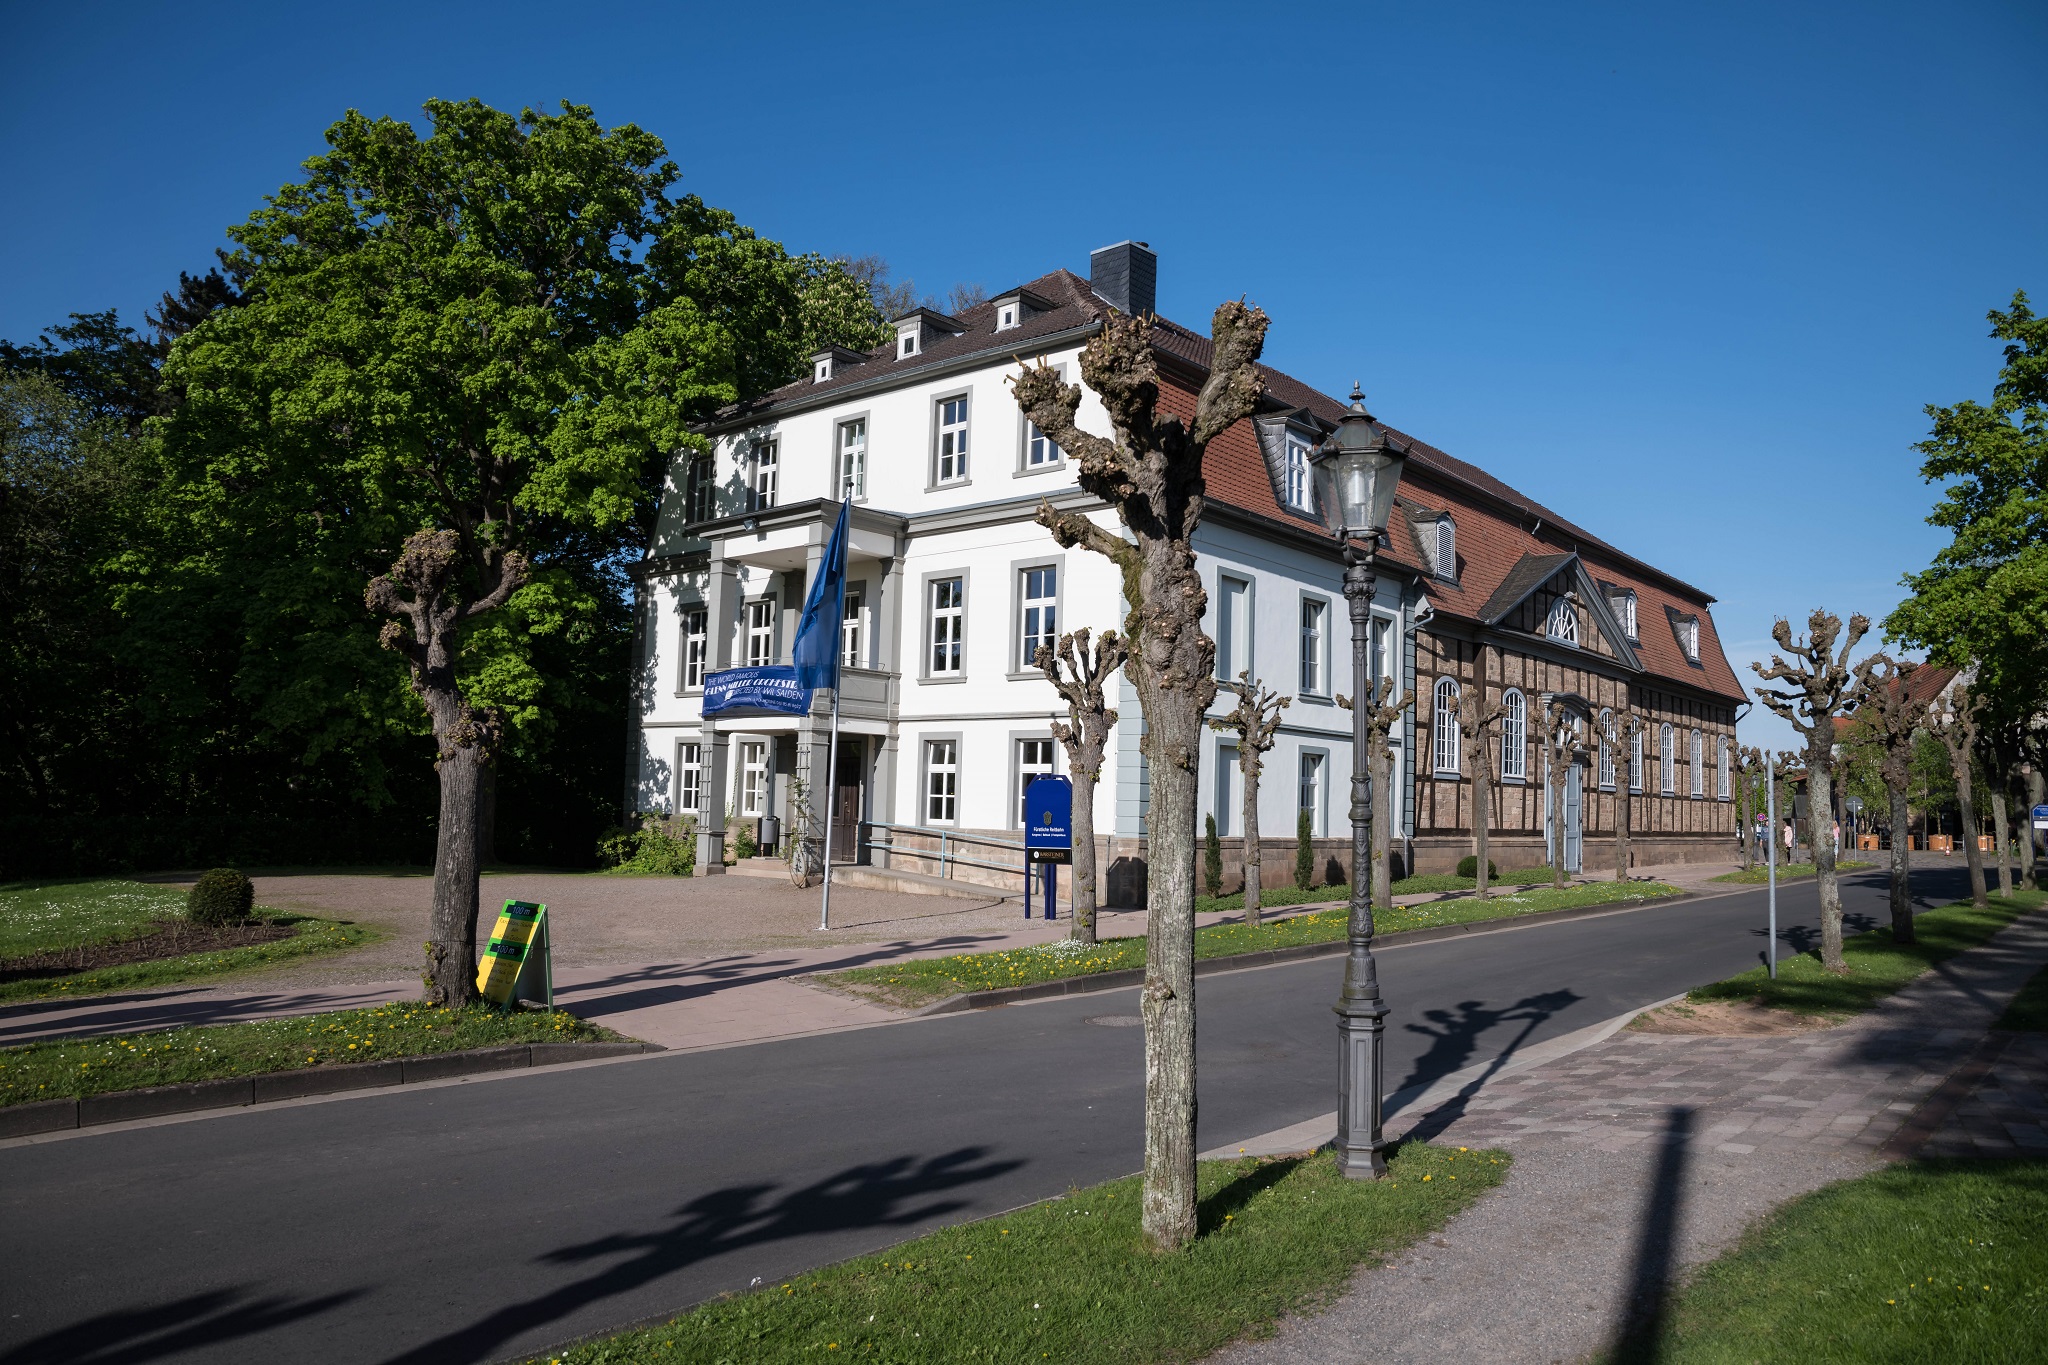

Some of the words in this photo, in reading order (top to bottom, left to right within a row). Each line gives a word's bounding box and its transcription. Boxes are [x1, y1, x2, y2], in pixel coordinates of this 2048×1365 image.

[708, 678, 717, 687] THE
[717, 674, 735, 684] WORLD
[736, 671, 760, 680] FAMOUS
[705, 684, 727, 696] GLENN
[727, 679, 753, 691] MILLER
[753, 686, 763, 694] BY
[763, 686, 775, 696] WIL
[776, 688, 804, 701] SALDEN
[512, 906, 524, 915] 100
[496, 944, 508, 954] 100
